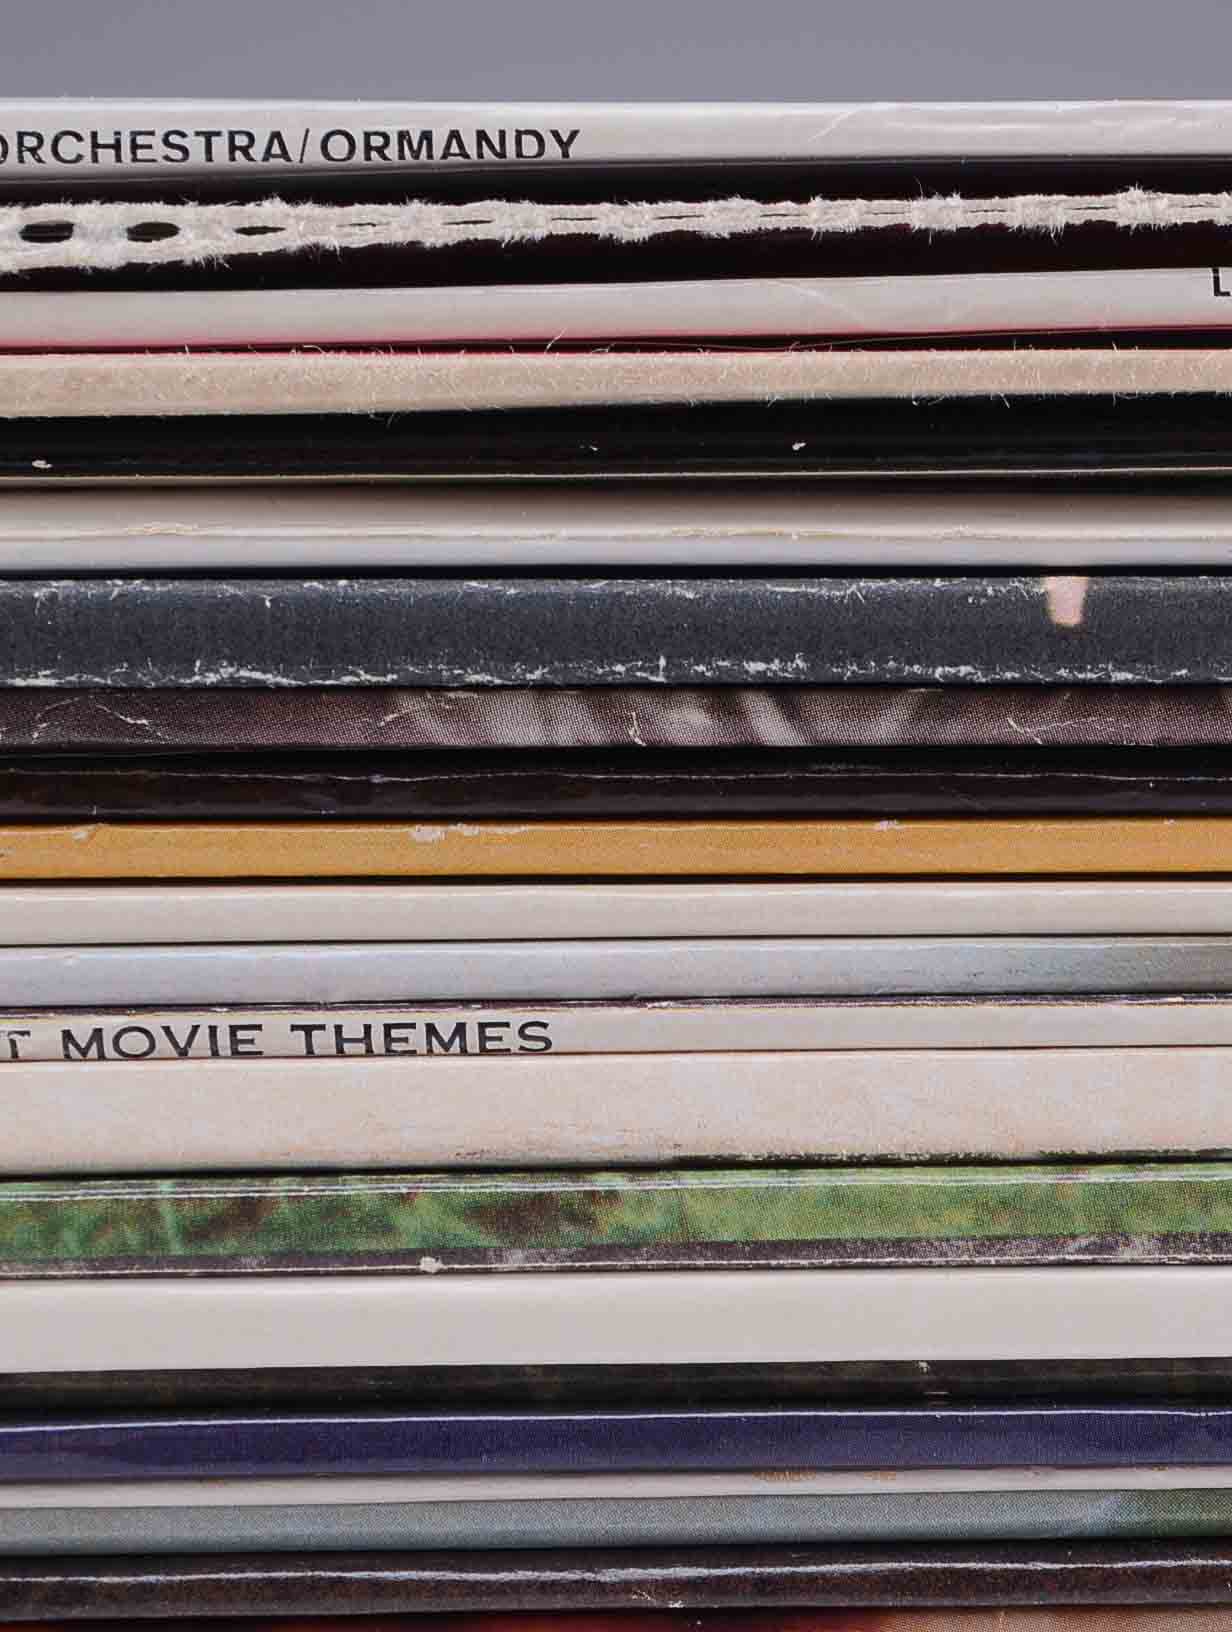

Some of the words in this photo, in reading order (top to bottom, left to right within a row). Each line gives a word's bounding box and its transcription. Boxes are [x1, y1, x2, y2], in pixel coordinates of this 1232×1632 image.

[0, 128, 581, 164] RCHESTRA/ORMANDY
[61, 1024, 264, 1061] MOVIE
[290, 1020, 553, 1056] THEMES
